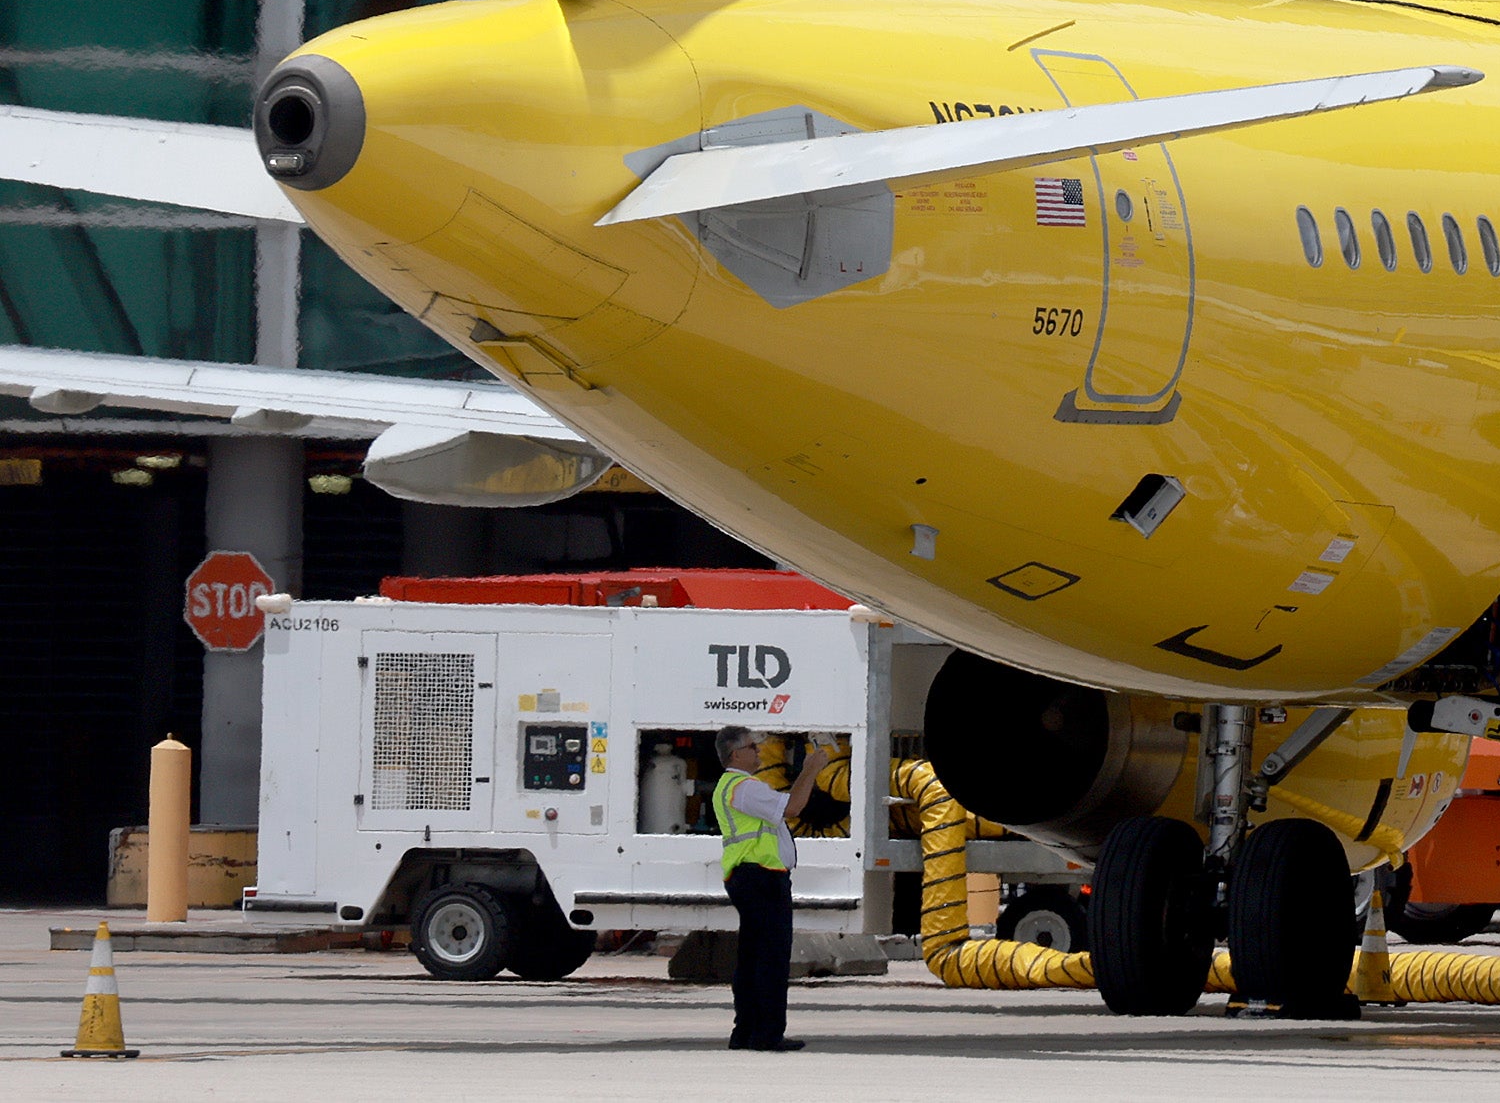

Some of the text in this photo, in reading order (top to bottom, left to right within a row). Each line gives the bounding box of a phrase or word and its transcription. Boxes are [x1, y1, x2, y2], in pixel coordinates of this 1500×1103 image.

[1032, 307, 1084, 337] 5670
[190, 581, 268, 619] STOP
[269, 617, 340, 632] ACU2106
[708, 644, 792, 689] TLD
[703, 697, 768, 713] swissport
